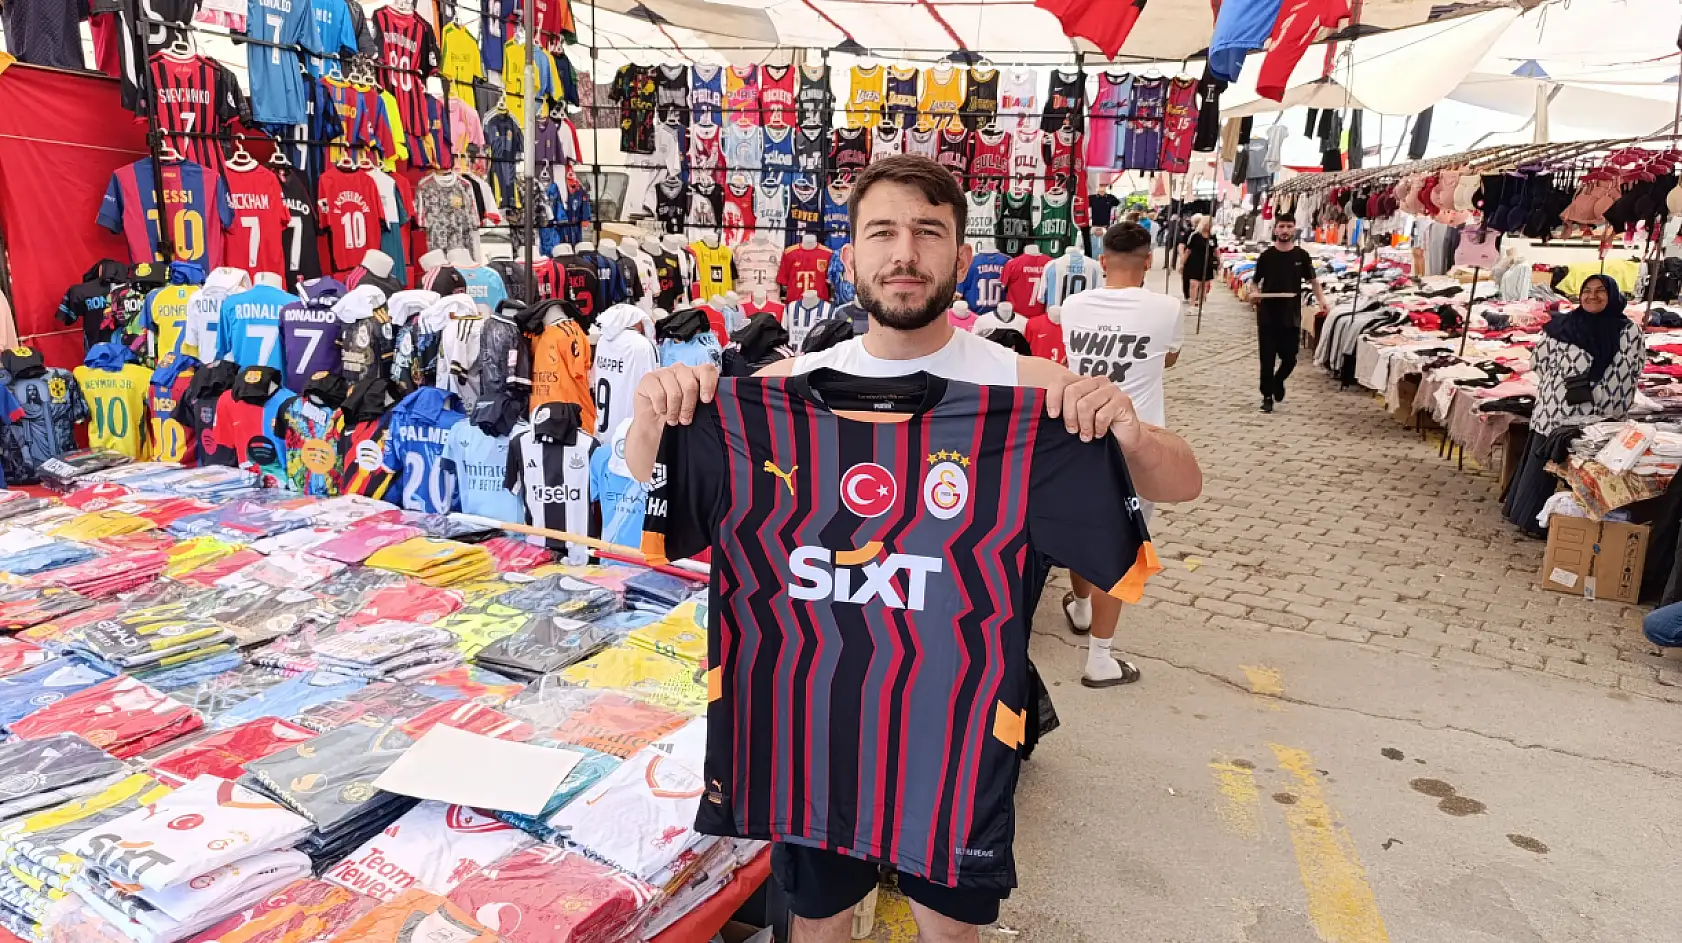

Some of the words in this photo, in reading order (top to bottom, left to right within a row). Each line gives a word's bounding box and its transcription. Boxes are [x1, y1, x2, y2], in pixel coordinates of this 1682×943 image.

[266, 14, 284, 64] 7
[179, 112, 196, 150] 7
[1177, 117, 1193, 130] 15
[240, 216, 260, 267] 7
[287, 216, 302, 271] 7
[340, 211, 367, 249] 10
[976, 278, 1002, 307] 10
[1028, 277, 1042, 307] 7
[285, 309, 336, 324] RONALDO
[246, 324, 279, 367] 7
[294, 328, 324, 375] 7
[1069, 330, 1151, 359] WHITE
[1079, 358, 1132, 382] FOX
[94, 396, 129, 439] 10
[597, 377, 612, 434] 9
[150, 418, 188, 463] 10
[402, 451, 456, 515] 20
[644, 496, 668, 518] HA
[358, 847, 416, 889] Team
